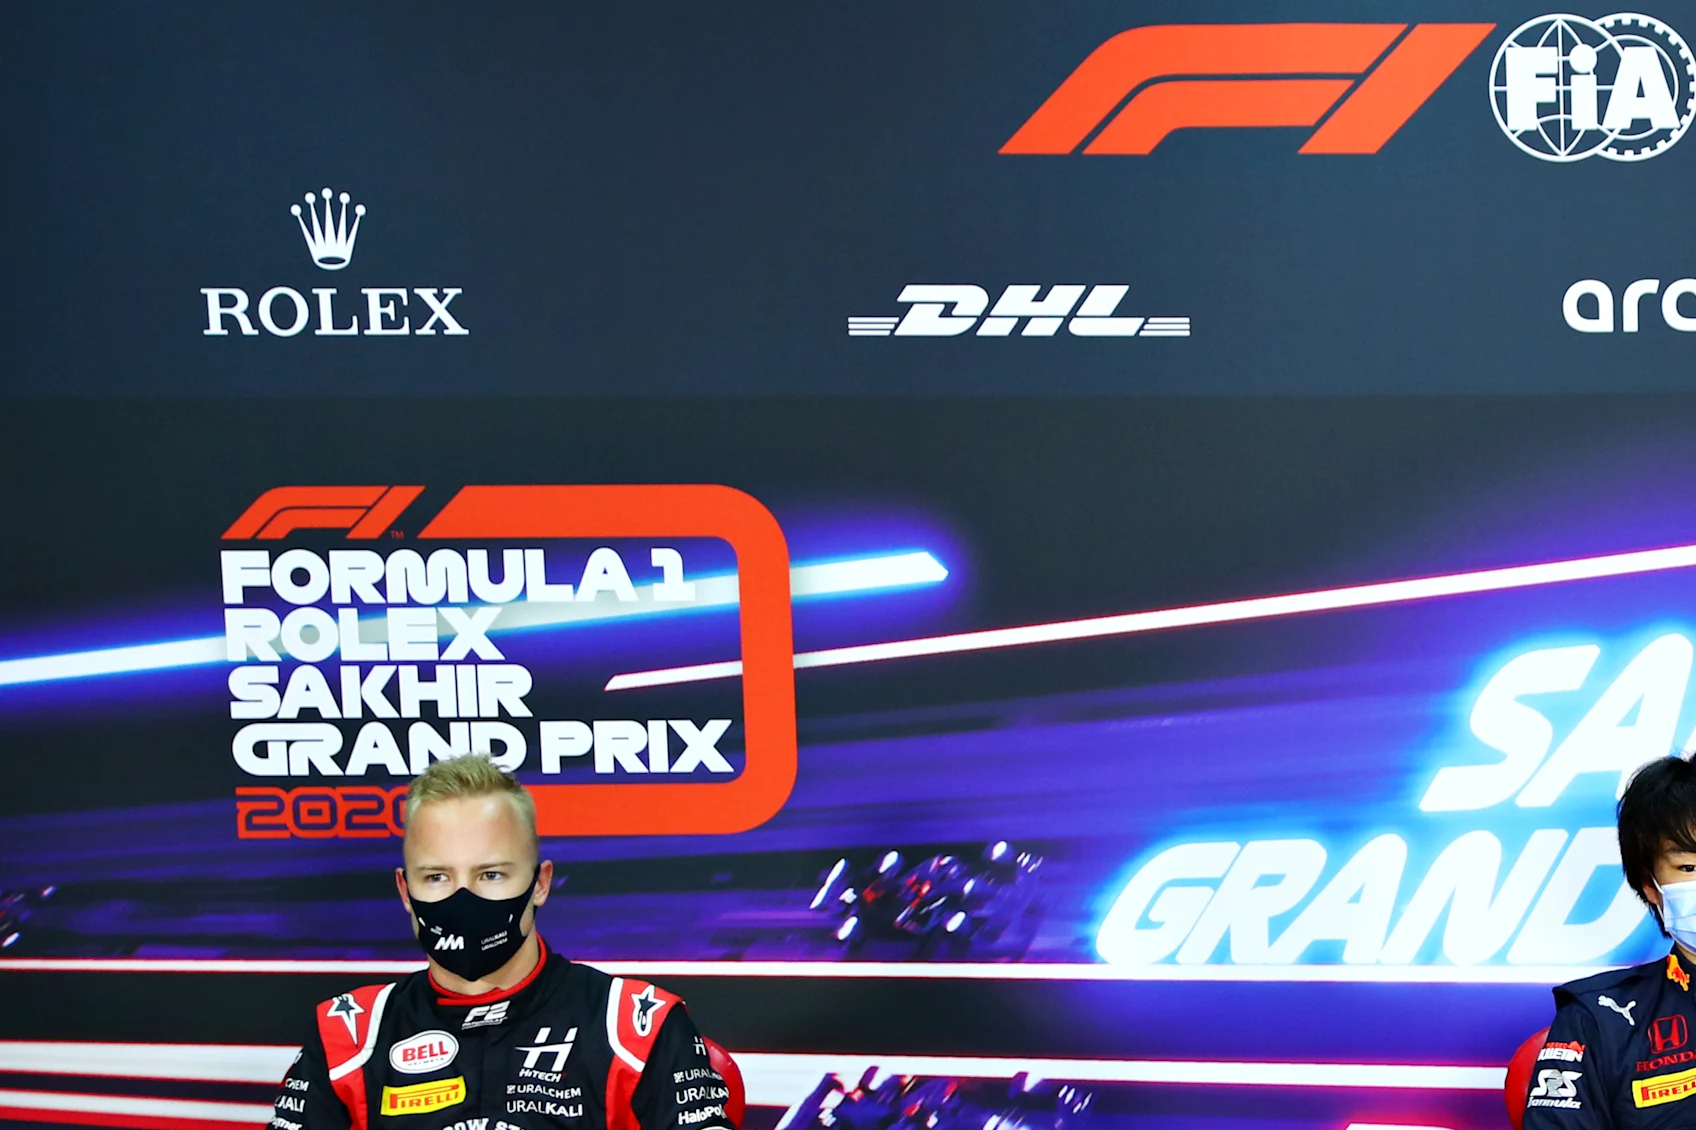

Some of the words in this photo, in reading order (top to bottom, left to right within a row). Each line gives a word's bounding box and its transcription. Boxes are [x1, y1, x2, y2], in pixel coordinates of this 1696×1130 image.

[202, 287, 470, 337] ROLEX
[893, 284, 1143, 337] DHL
[220, 548, 639, 605] FORMULA
[649, 547, 696, 602] 1
[223, 607, 506, 662] ROLEX
[227, 664, 534, 719] SAKHIR
[231, 720, 528, 777] GRAND
[538, 719, 735, 775] PRIX
[464, 1000, 510, 1022] F2
[402, 1041, 449, 1062] BELL
[390, 1084, 460, 1109] PIRELLI
[506, 1100, 583, 1117] URALKALI
[516, 1083, 582, 1099] URALCHEM
